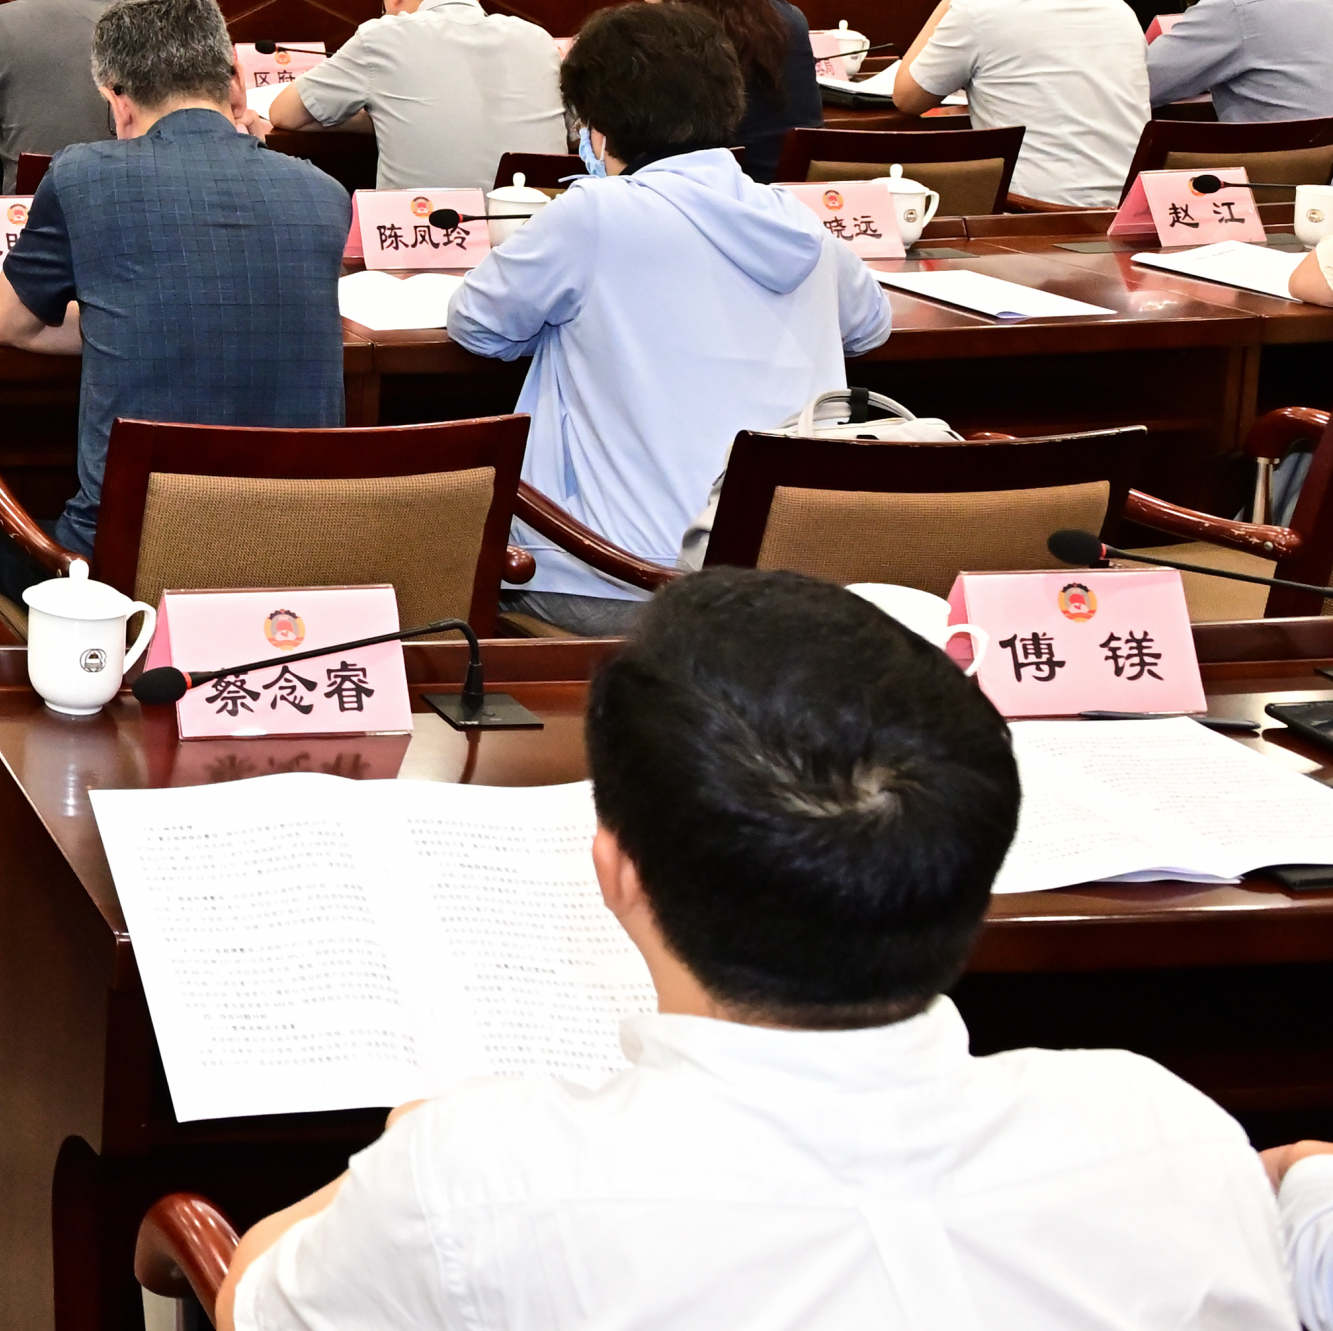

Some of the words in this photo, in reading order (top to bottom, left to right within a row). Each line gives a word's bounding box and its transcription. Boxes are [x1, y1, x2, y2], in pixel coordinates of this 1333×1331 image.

[376, 223, 471, 251] 陈凤玲
[205, 659, 375, 718] 蔡念睿
